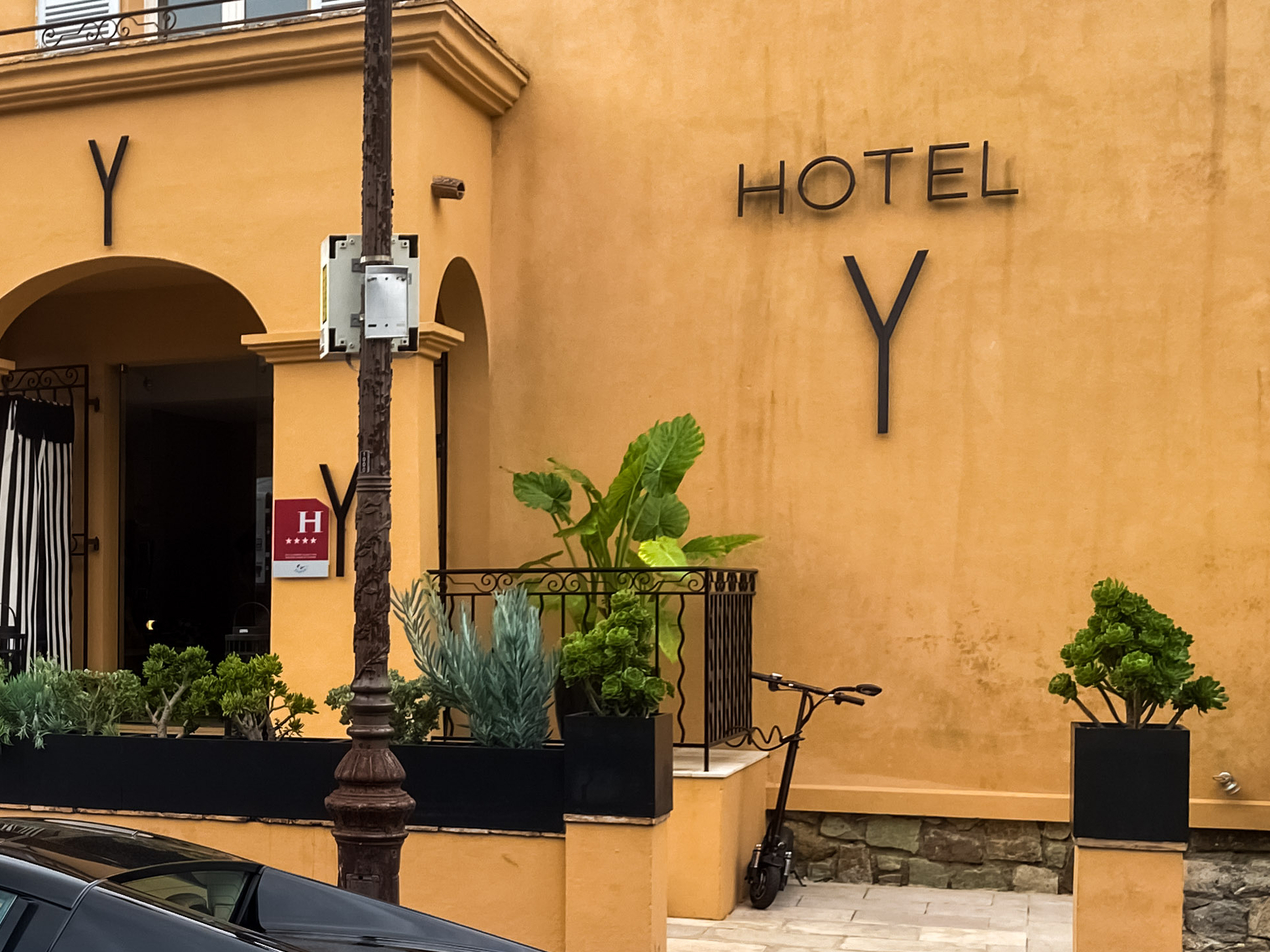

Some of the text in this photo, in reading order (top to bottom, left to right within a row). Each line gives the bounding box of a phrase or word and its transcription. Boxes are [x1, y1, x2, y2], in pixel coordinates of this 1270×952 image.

[89, 136, 129, 247] Y
[738, 141, 1019, 218] HOTEL
[843, 250, 929, 434] Y
[297, 511, 323, 534] H
[320, 464, 359, 577] Y
